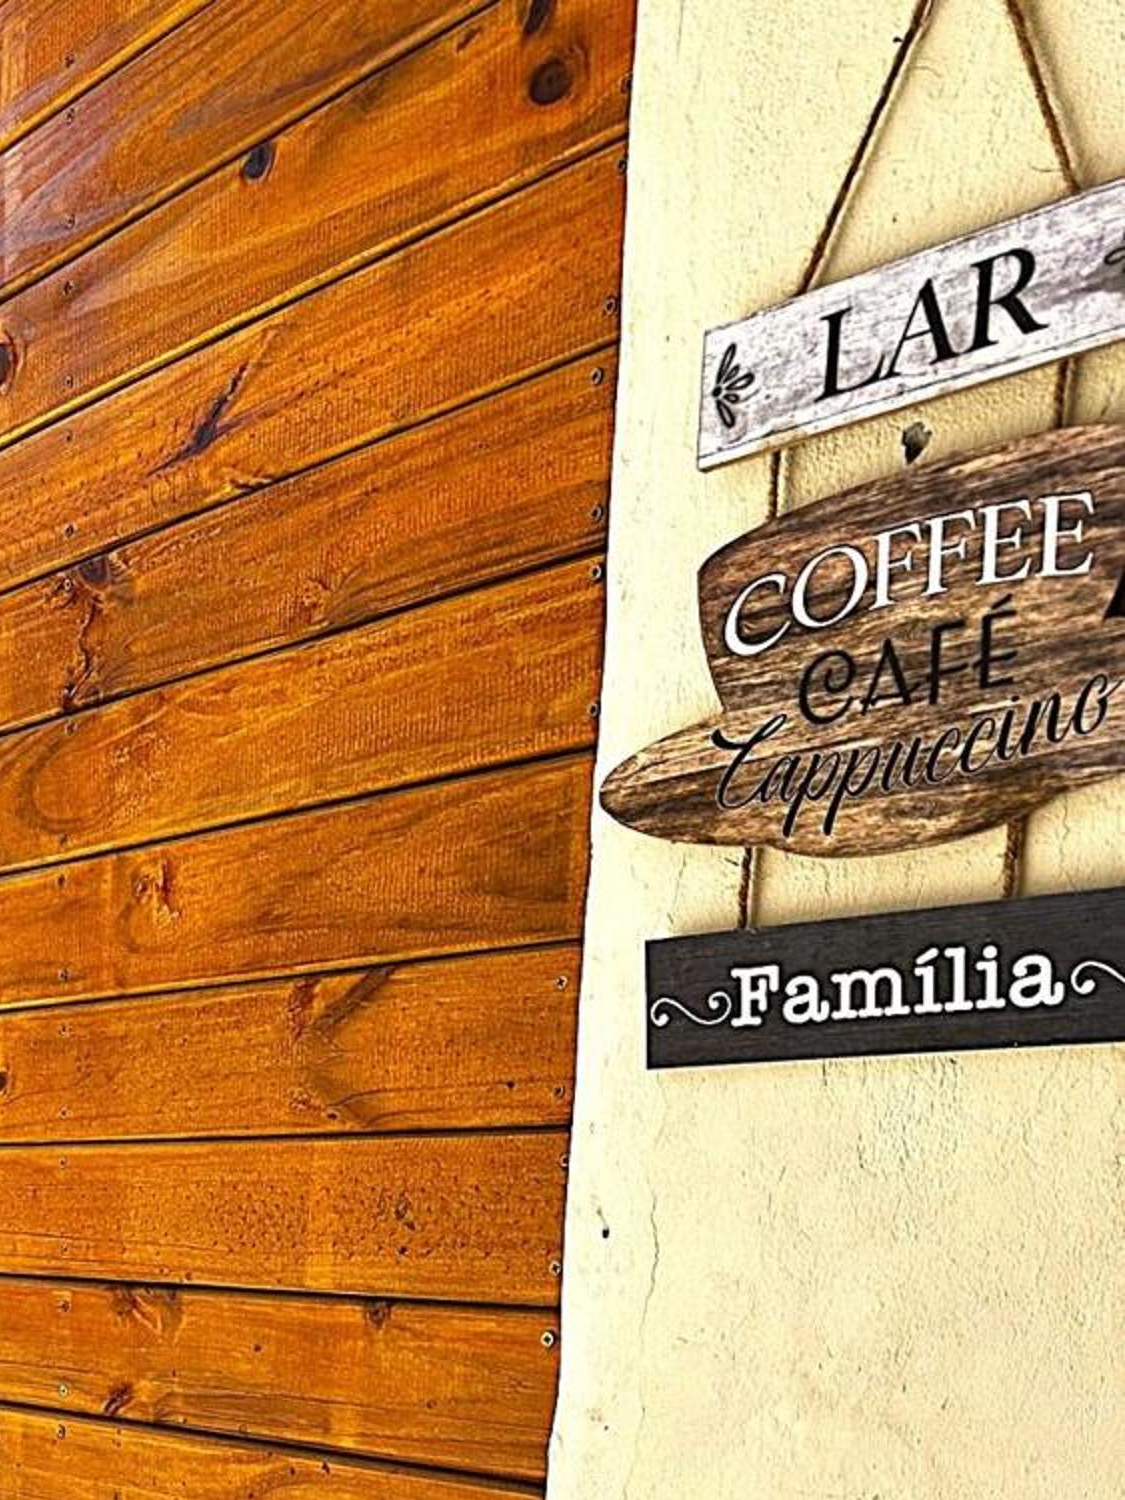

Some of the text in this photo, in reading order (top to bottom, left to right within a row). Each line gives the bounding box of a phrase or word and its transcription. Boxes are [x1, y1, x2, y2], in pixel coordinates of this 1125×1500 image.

[816, 247, 1048, 402] LAR
[724, 492, 1095, 657] COFFEE
[797, 594, 1017, 725] CAFÉ
[711, 673, 1123, 837] Cappuccino
[729, 945, 1066, 1029] Família
